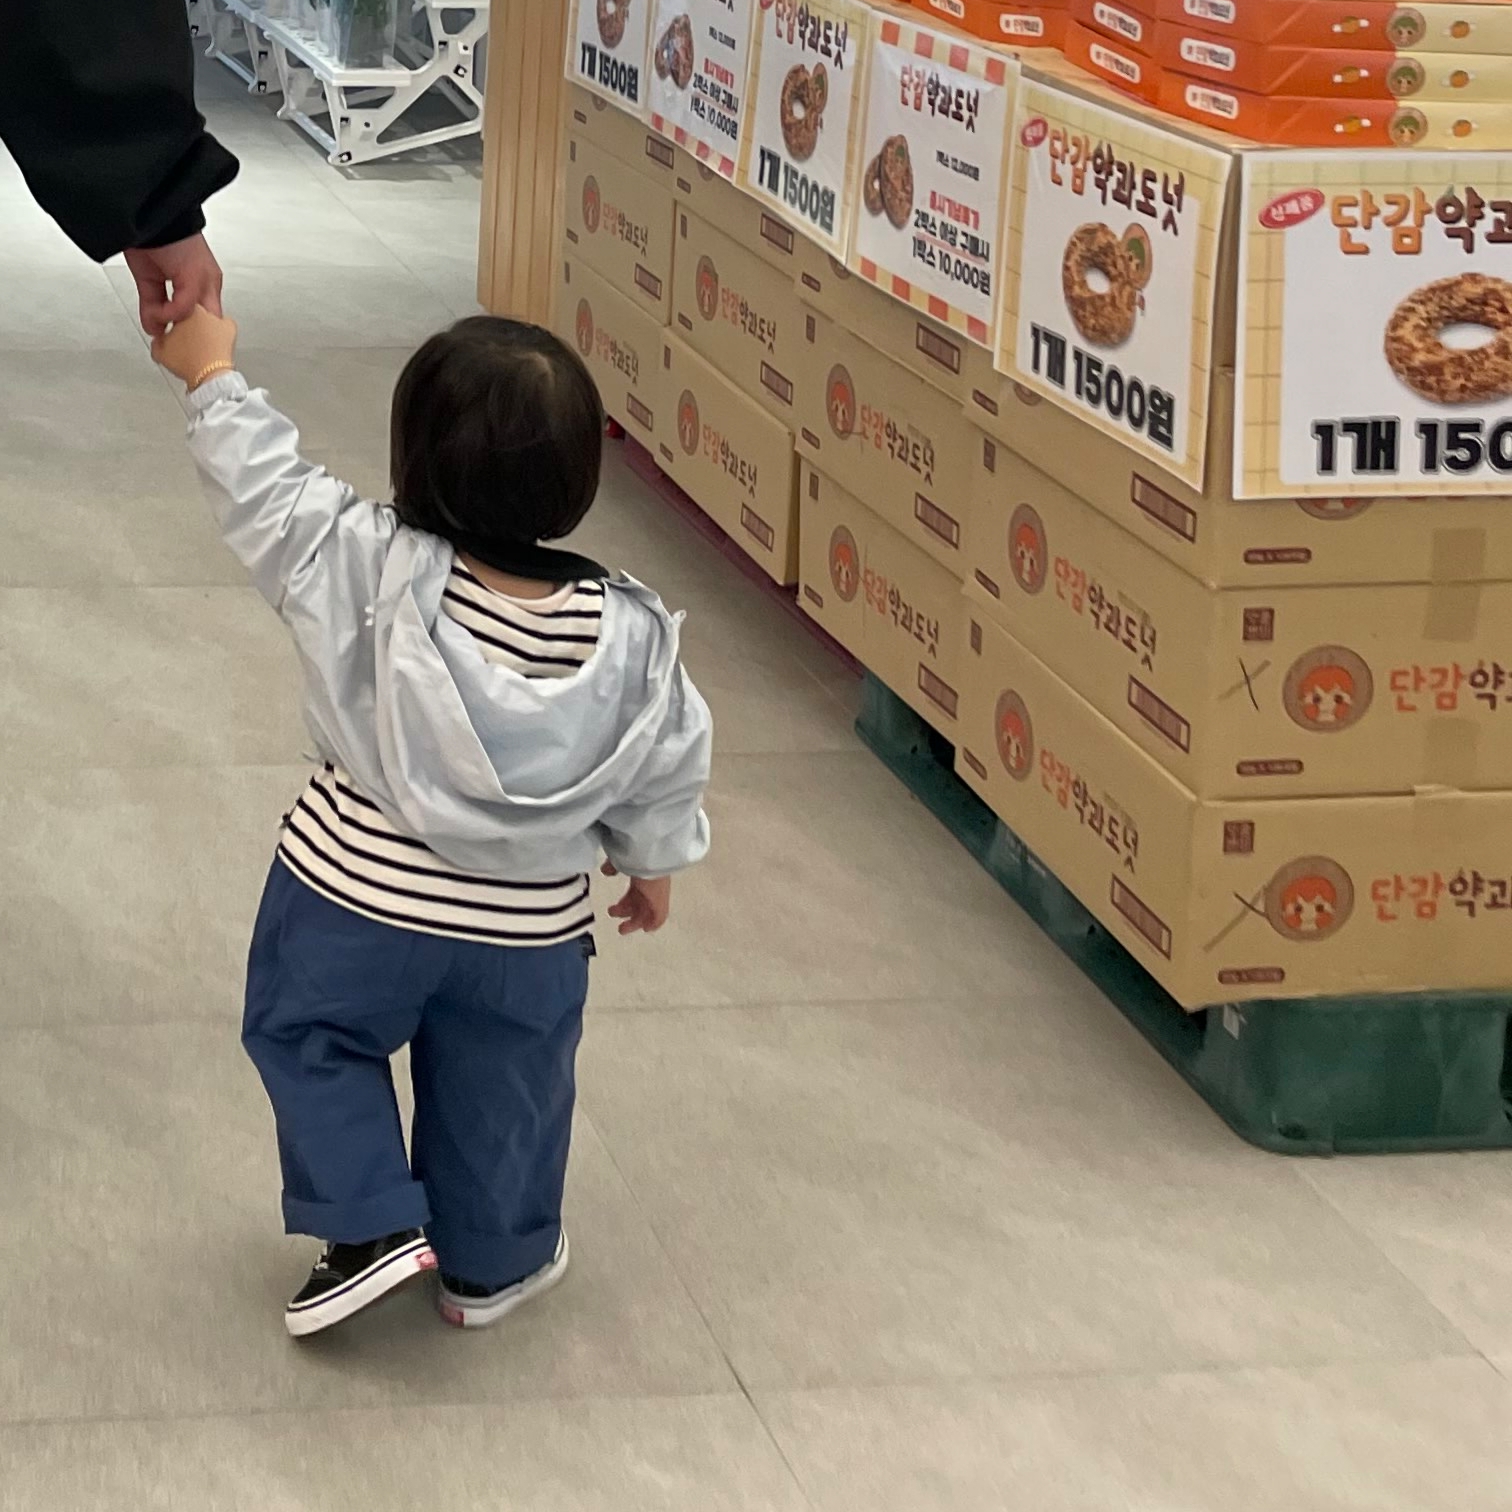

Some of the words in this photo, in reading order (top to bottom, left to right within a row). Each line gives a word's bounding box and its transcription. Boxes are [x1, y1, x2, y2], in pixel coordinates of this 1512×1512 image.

[598, 50, 639, 103] 1500원
[900, 64, 979, 134] 단감약과도넛
[758, 145, 781, 196] 1개
[783, 161, 836, 236] 1500원
[1049, 126, 1186, 237] 단감약과도넛
[912, 236, 936, 269] 1박스
[938, 249, 991, 297] 10,000원
[1029, 321, 1067, 390] 1개
[1072, 345, 1177, 454] 1500원
[702, 423, 758, 498] 단감약과도넛
[860, 402, 936, 486] 단감약과도넛
[1312, 416, 1401, 476] 1개
[863, 565, 940, 659] 단감약과도넛
[1054, 555, 1157, 673] 단감약과도넛
[1039, 748, 1139, 874] 단감약과도넛
